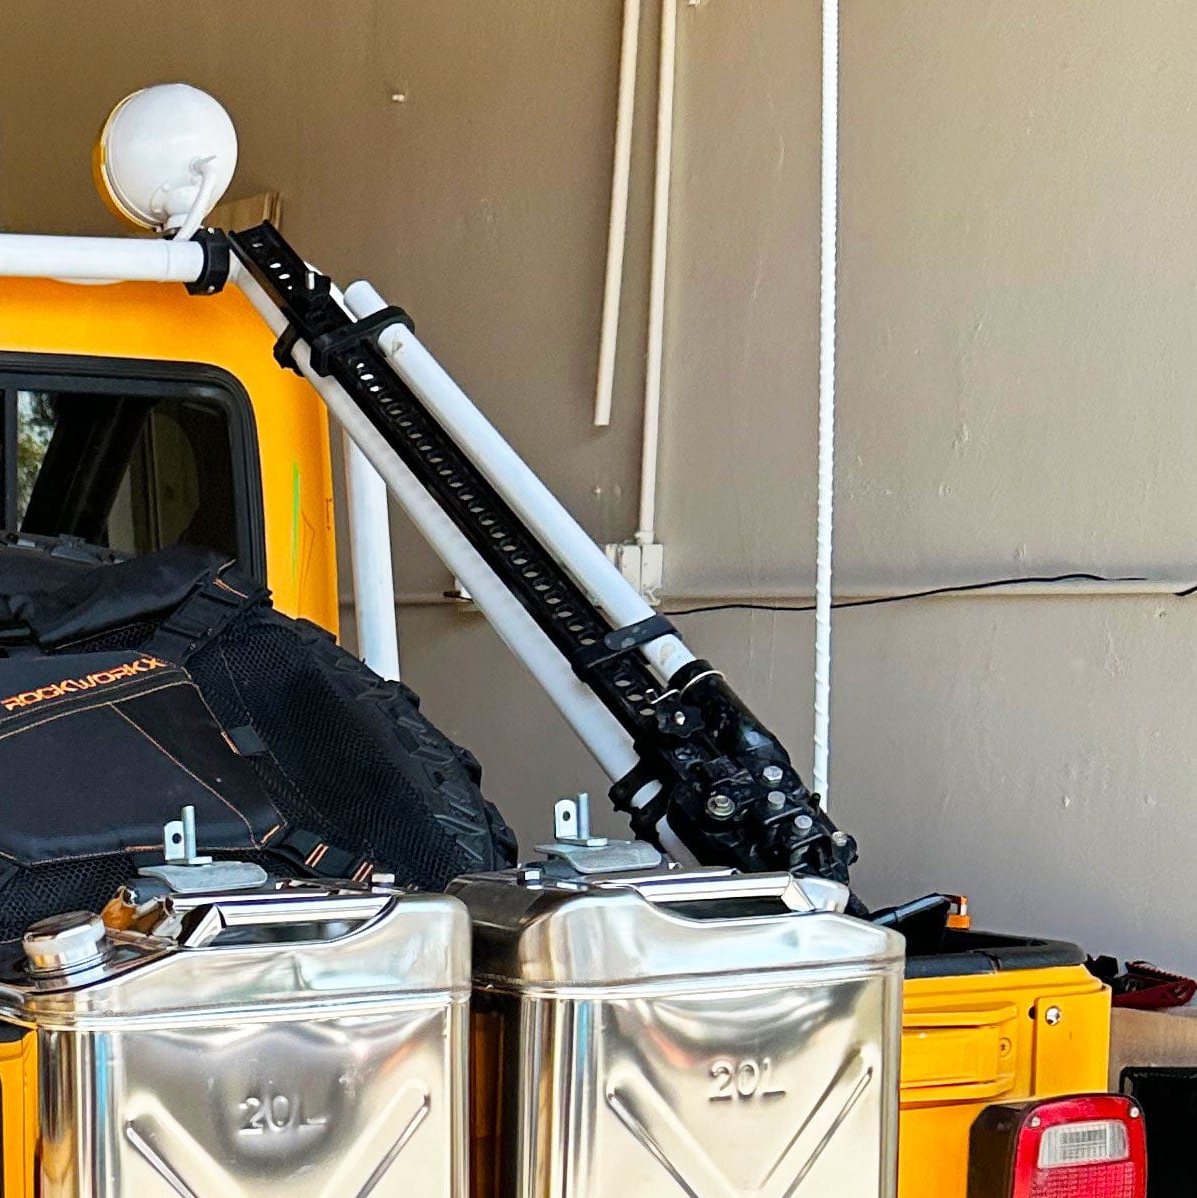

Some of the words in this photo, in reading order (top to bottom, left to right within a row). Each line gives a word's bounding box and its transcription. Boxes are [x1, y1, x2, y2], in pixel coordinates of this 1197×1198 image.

[0, 657, 167, 711] ROCKWORKX
[707, 1056, 786, 1102] 20L
[238, 1094, 328, 1136] 20L
